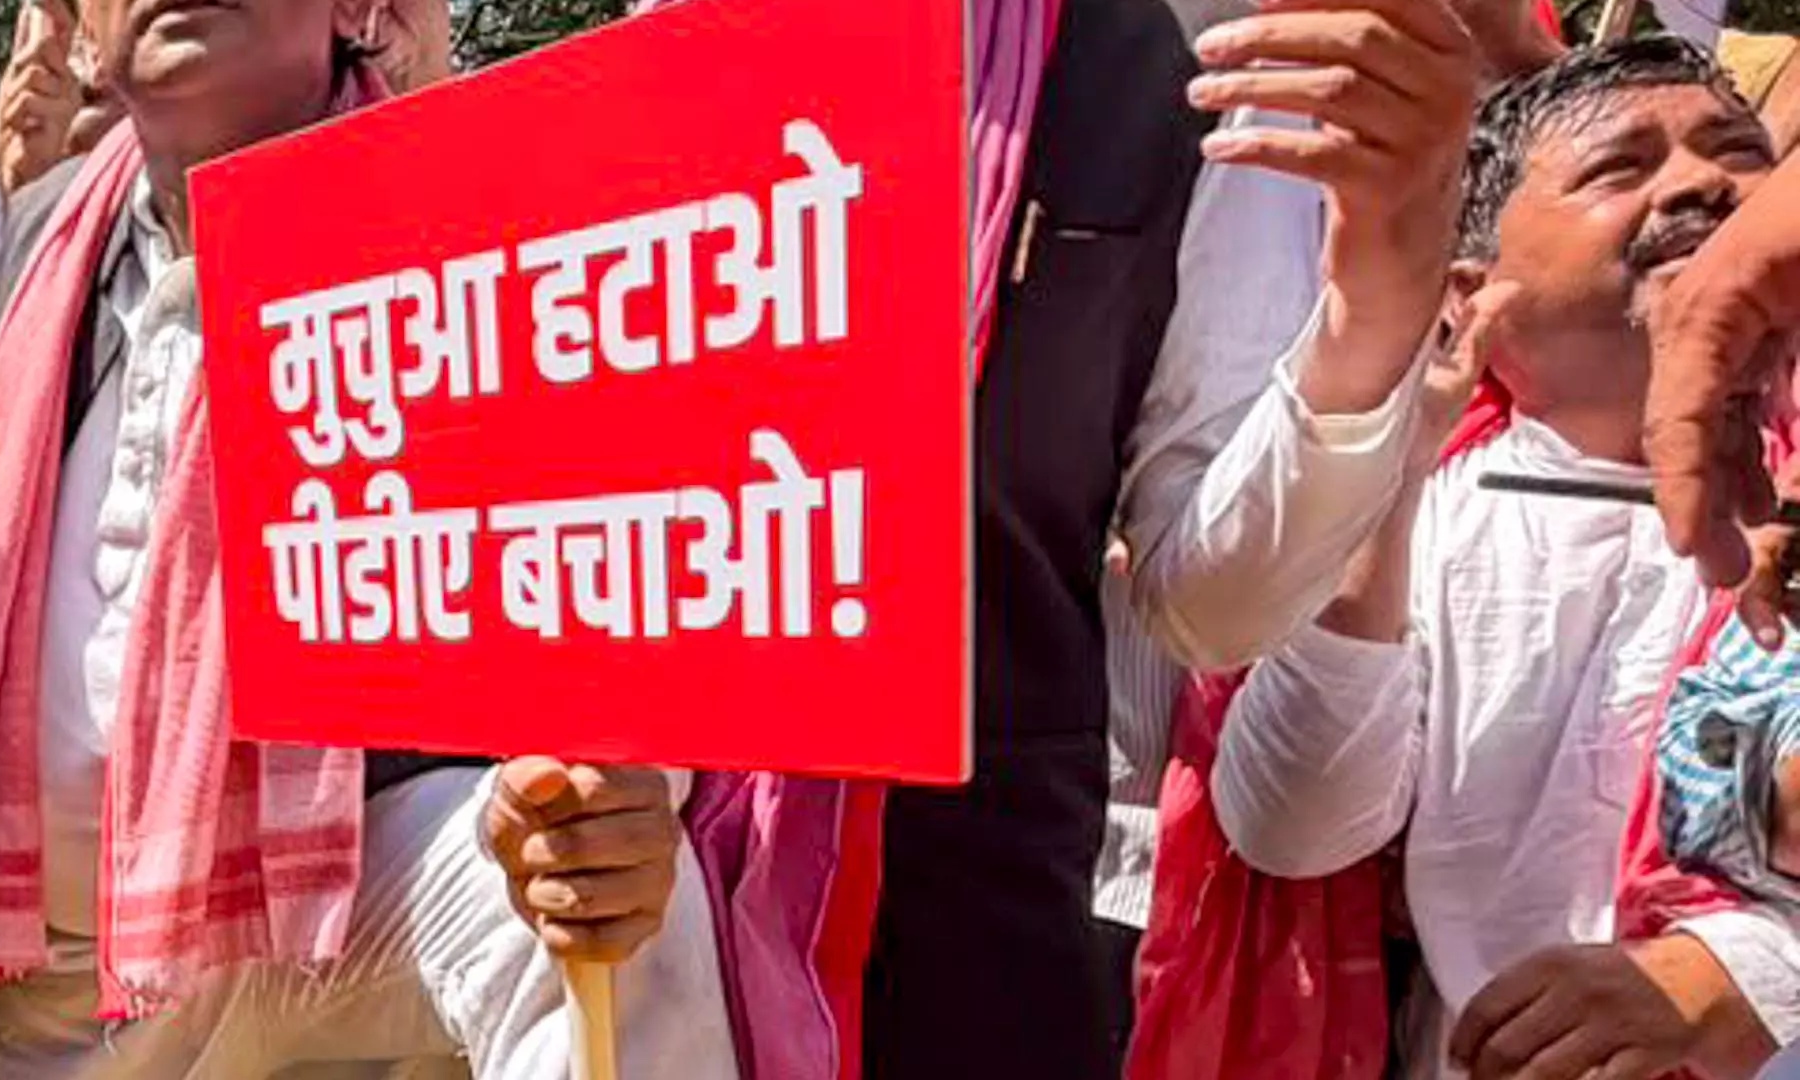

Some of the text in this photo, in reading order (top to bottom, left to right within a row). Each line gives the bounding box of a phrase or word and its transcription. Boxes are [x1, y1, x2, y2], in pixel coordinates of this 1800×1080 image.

[260, 118, 864, 467] मुचुआ हटाओ
[262, 429, 868, 643] पीडीए बचाओ!
